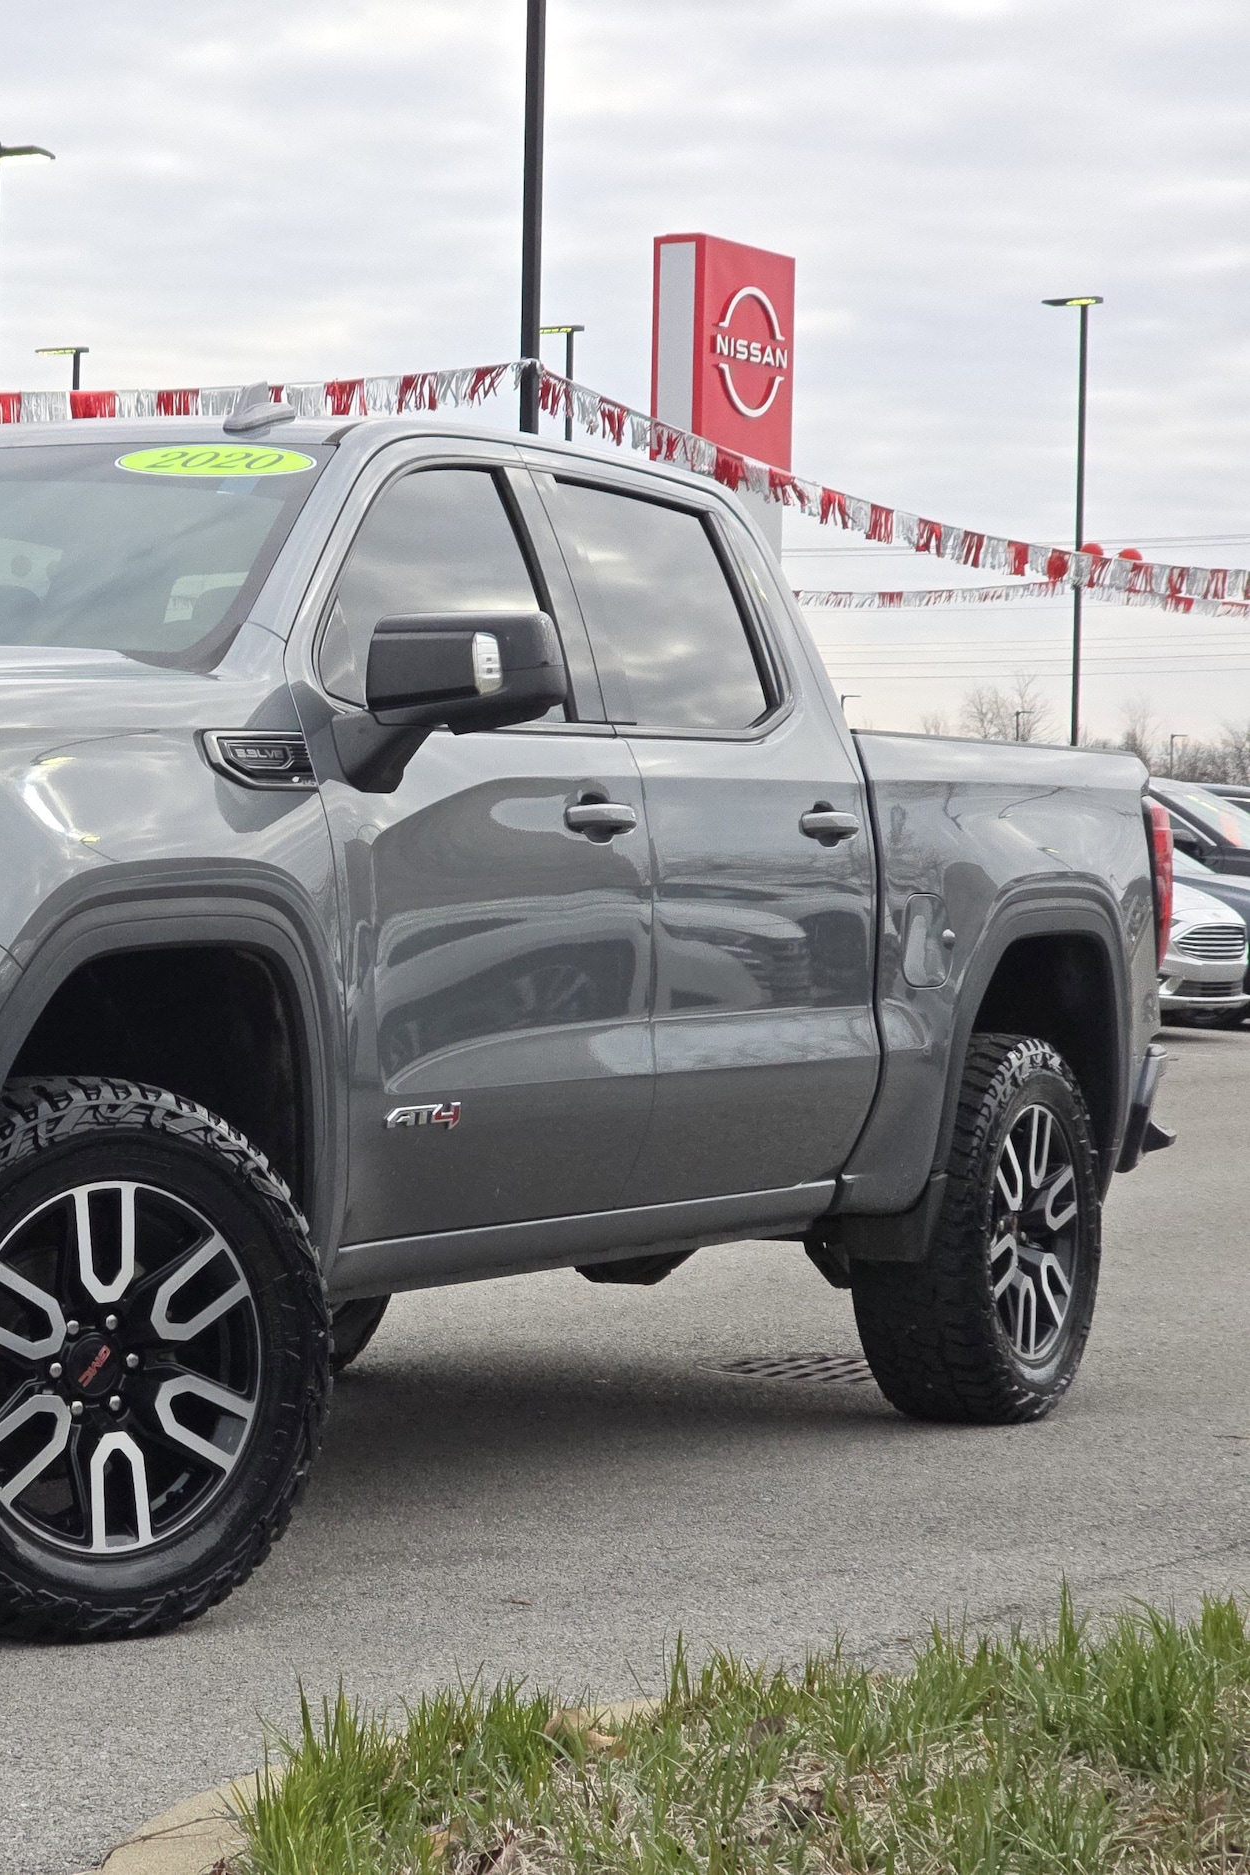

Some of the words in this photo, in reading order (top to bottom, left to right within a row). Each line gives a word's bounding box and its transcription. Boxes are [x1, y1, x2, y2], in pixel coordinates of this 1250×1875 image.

[716, 333, 788, 369] NISSAN
[145, 451, 285, 470] 2020
[386, 1101, 461, 1129] AT4
[78, 1345, 111, 1388] GMC
